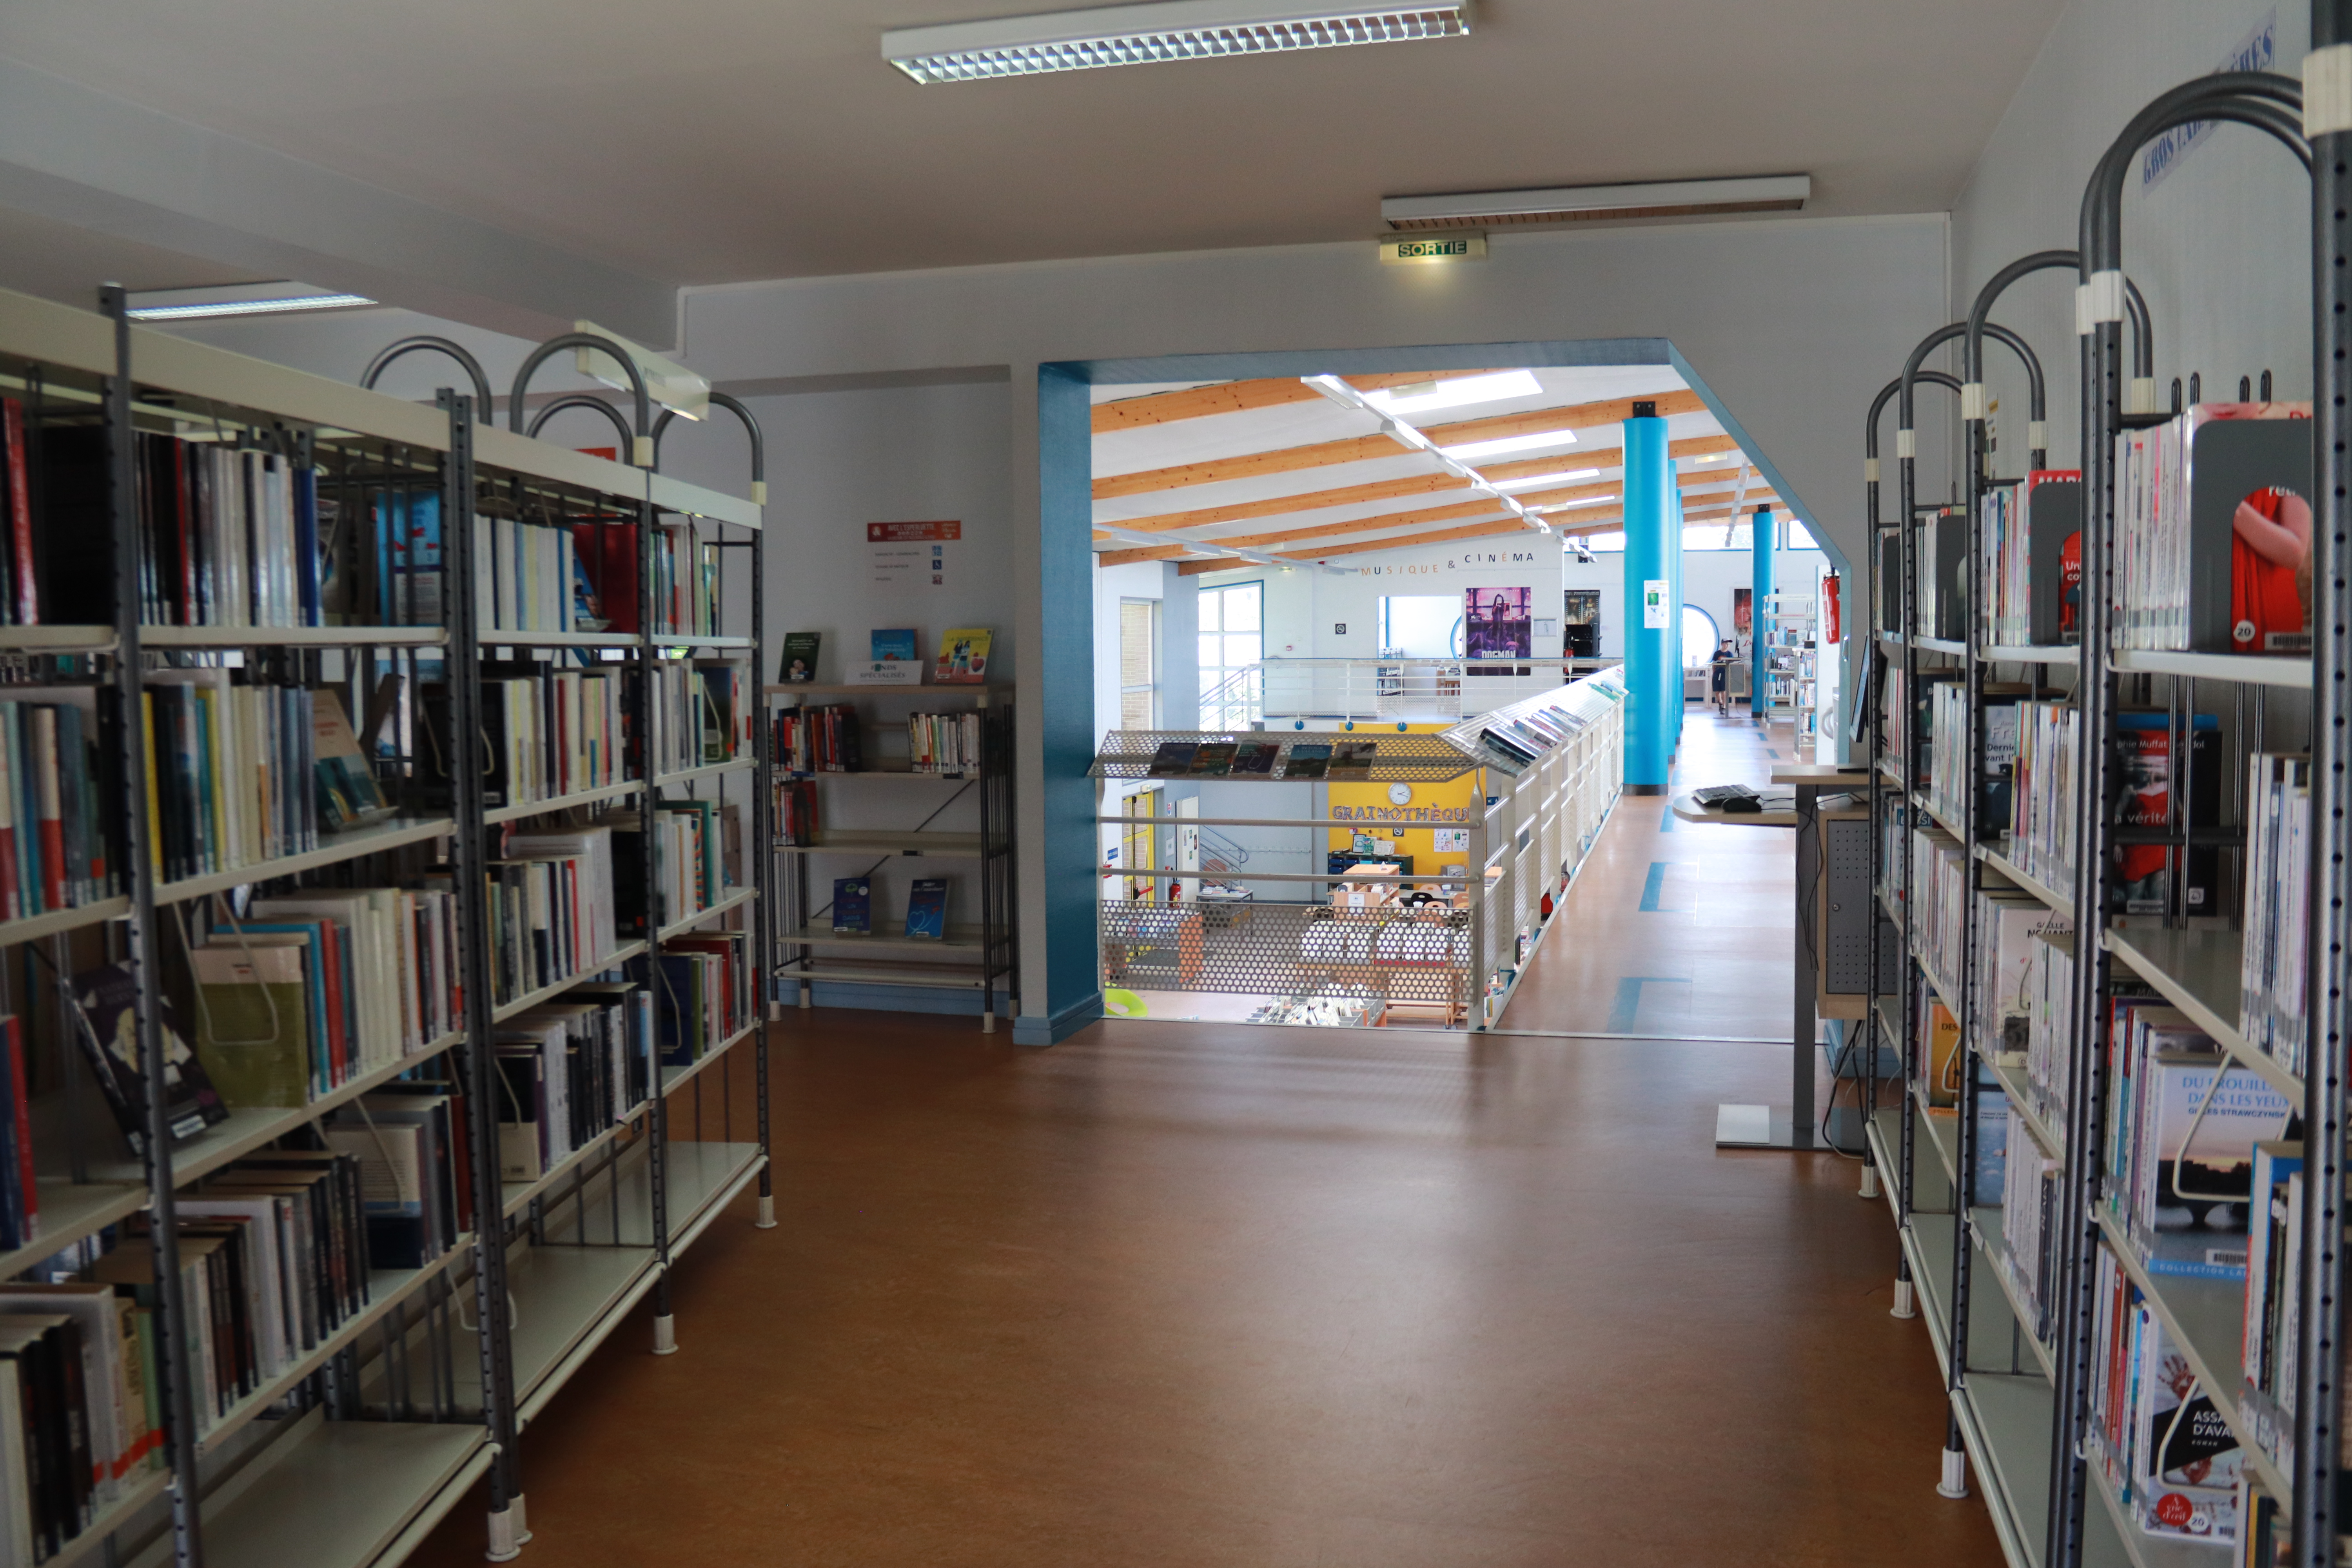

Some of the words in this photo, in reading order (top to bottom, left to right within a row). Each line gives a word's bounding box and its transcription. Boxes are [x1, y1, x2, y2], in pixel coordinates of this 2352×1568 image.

[2144, 132, 2174, 184] GROS
[1399, 241, 1465, 256] SORTIE
[1361, 564, 1439, 577] MUSIQUE
[1448, 560, 1455, 569] &
[1465, 552, 1534, 563] CINÉMA
[2238, 628, 2250, 637] 20
[1482, 650, 1516, 659] DOGMAN
[2139, 740, 2169, 748] Muffat
[2183, 1077, 2203, 1088] DU
[2230, 1095, 2251, 1106] LES
[2160, 1264, 2225, 1275] COLLECTION
